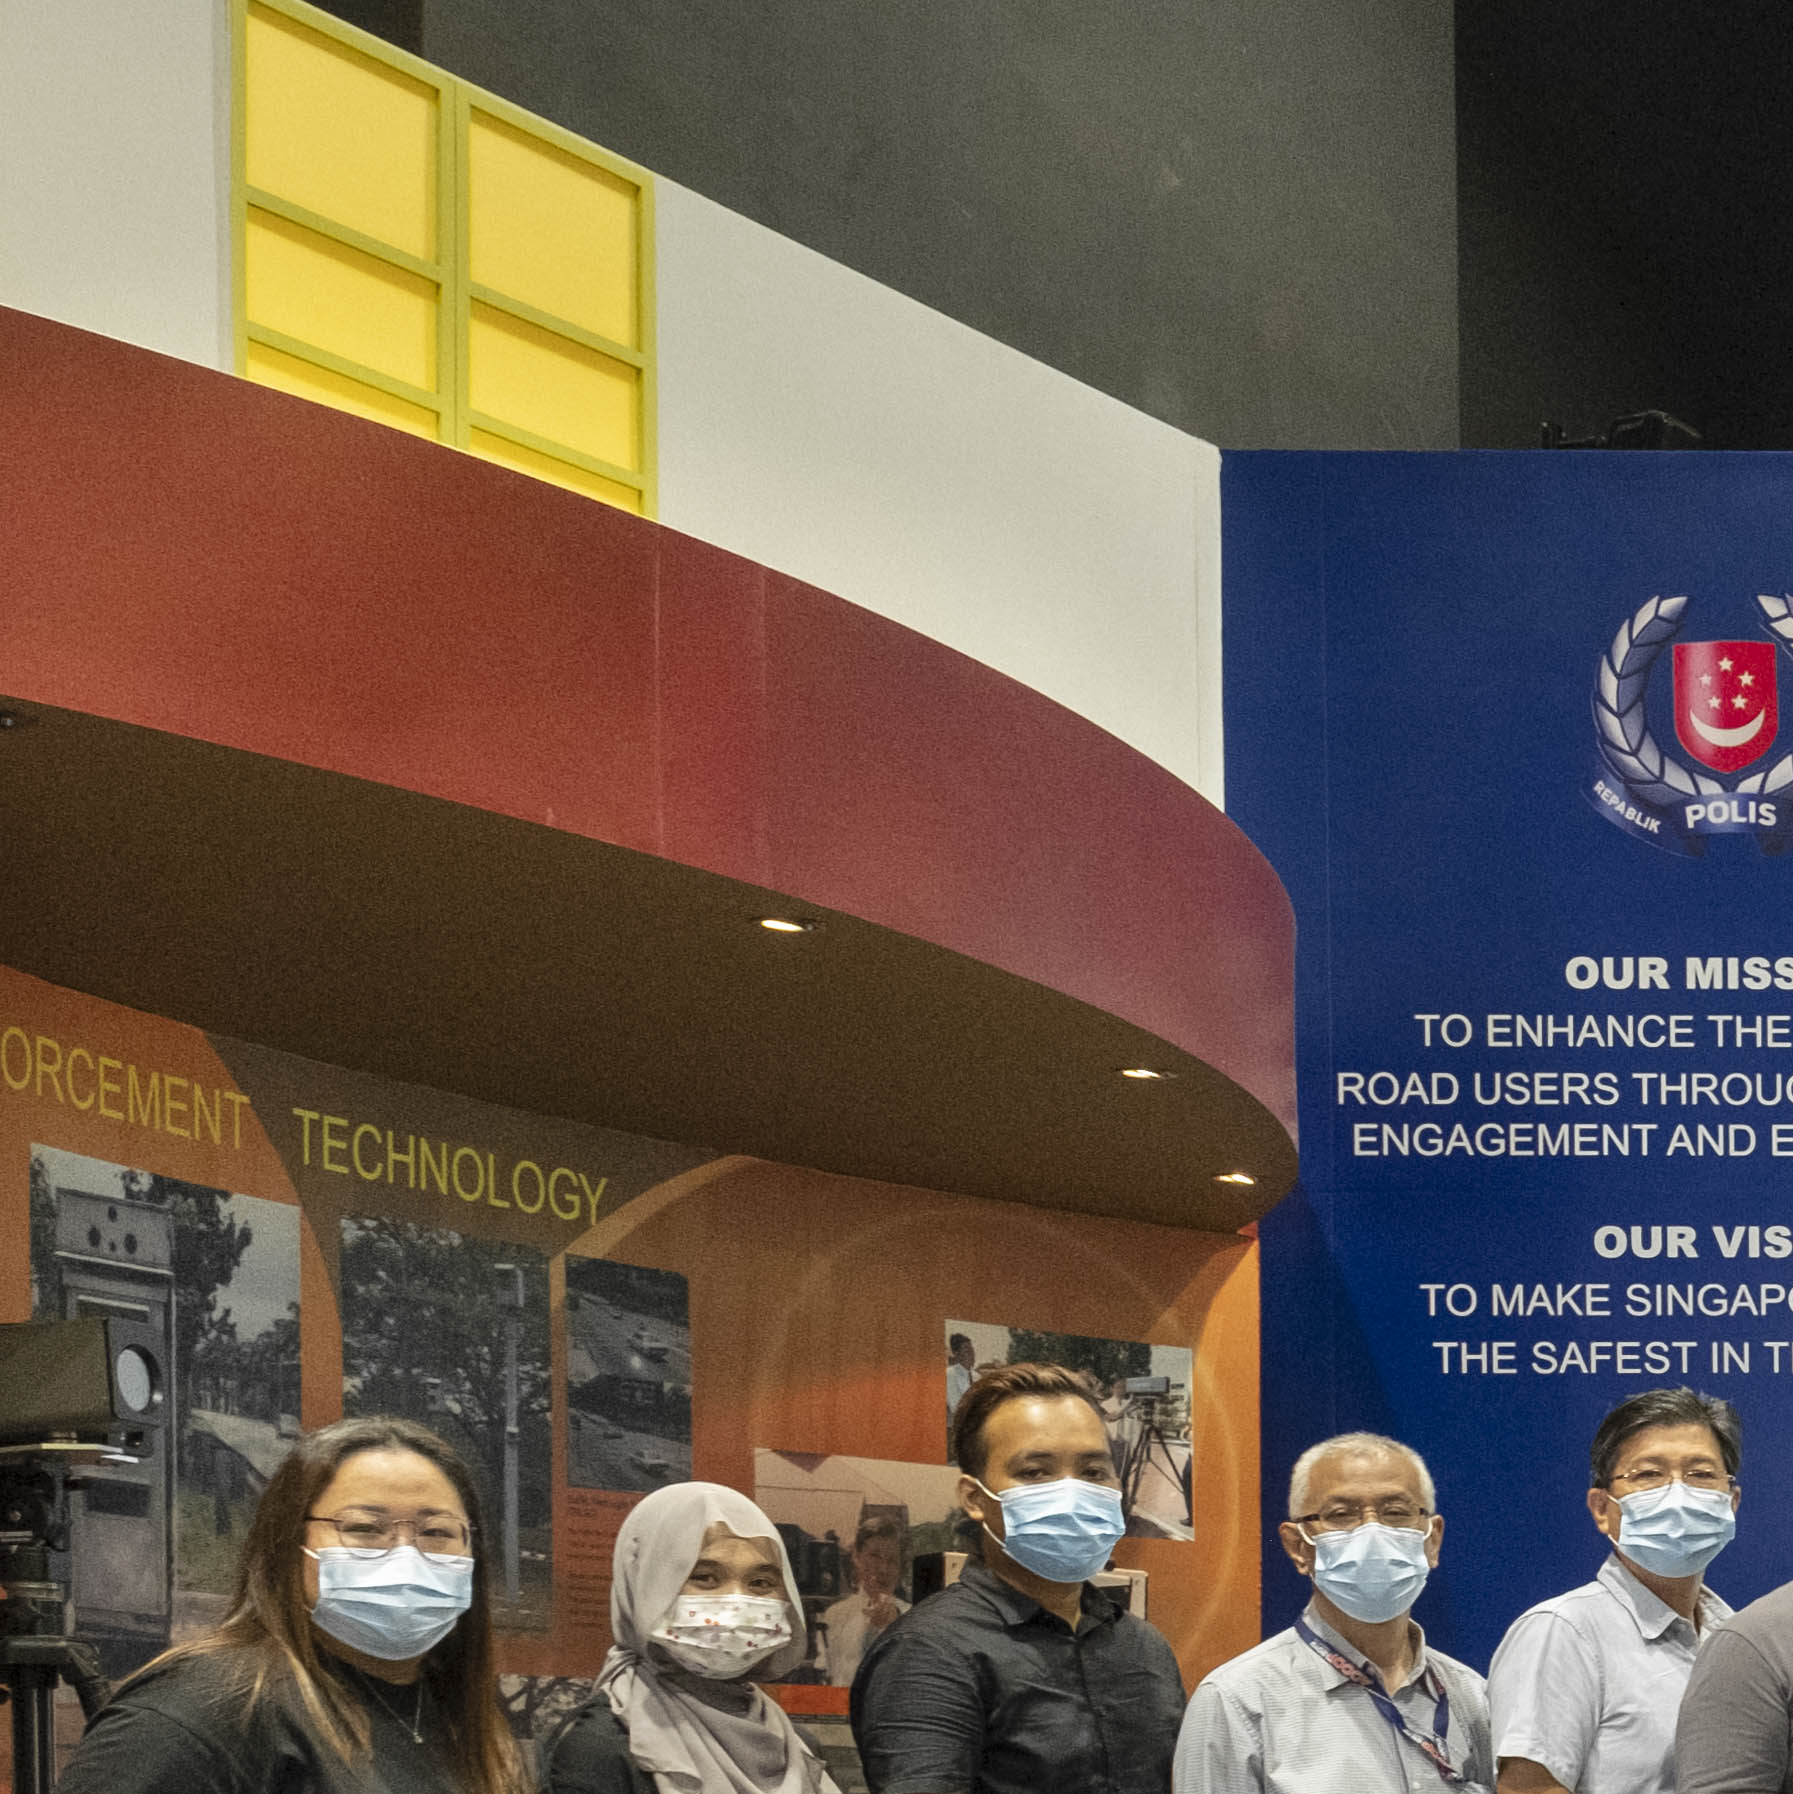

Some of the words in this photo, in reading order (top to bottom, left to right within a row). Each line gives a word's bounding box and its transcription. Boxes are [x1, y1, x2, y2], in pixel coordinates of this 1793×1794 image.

[1685, 800, 1777, 829] POLIS
[1565, 956, 1671, 990] OUR
[1414, 1013, 1473, 1048] TO
[1487, 1014, 1695, 1048] ENHANCE
[1706, 1014, 1793, 1048] THE
[1337, 1071, 1459, 1106] ROAD
[1474, 1072, 1620, 1106] USERS
[1353, 1123, 1659, 1157] ENGAGEMENT
[1666, 1123, 1757, 1157] AND
[292, 1107, 608, 1226] TECHNOLOGY
[1593, 1225, 1699, 1259] OUR
[1419, 1283, 1477, 1317] TO
[1492, 1283, 1612, 1317] MAKE
[1432, 1341, 1518, 1374] THE
[1531, 1341, 1698, 1375] SAFEST
[1711, 1341, 1750, 1374] IN
